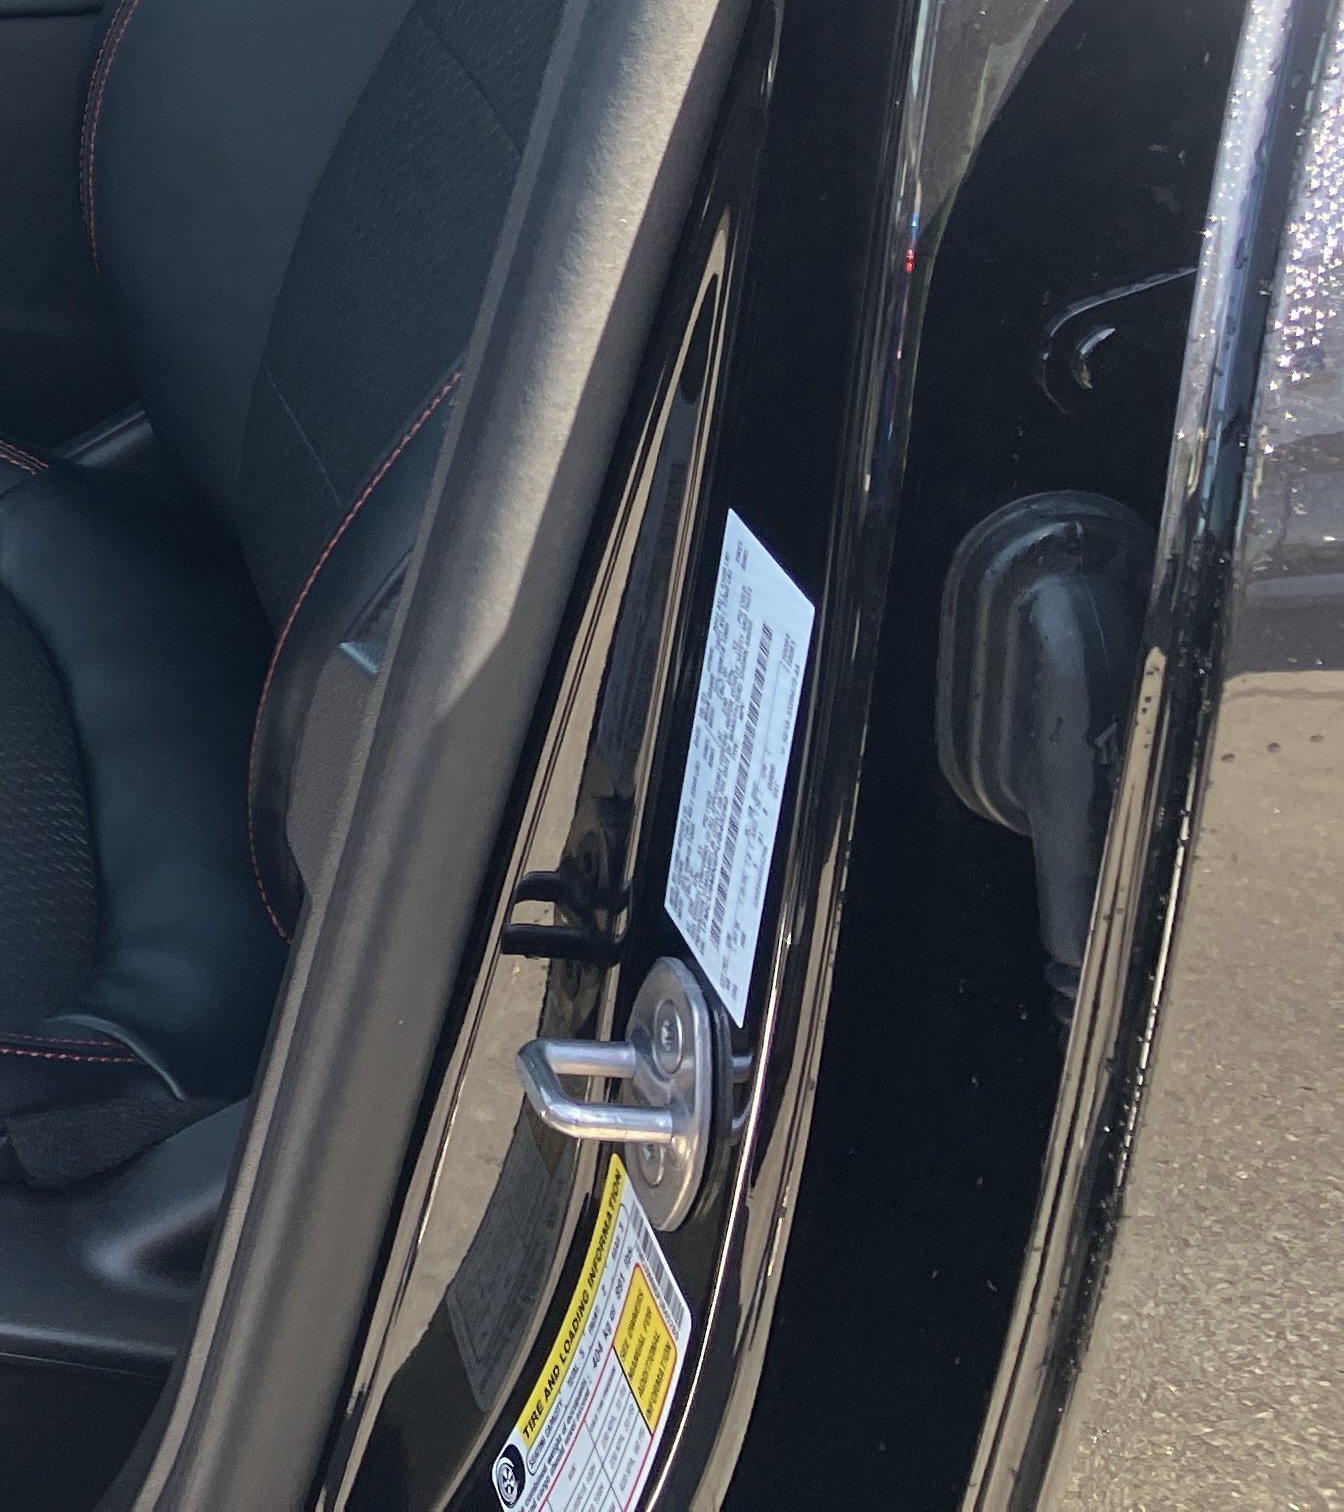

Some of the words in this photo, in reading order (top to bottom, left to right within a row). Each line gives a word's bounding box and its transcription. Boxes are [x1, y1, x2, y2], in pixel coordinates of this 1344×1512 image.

[522, 1398, 546, 1439] TIRE
[544, 1363, 560, 1401] AND
[557, 1289, 590, 1363] LOADING
[586, 1169, 622, 1288] INFORMATION
